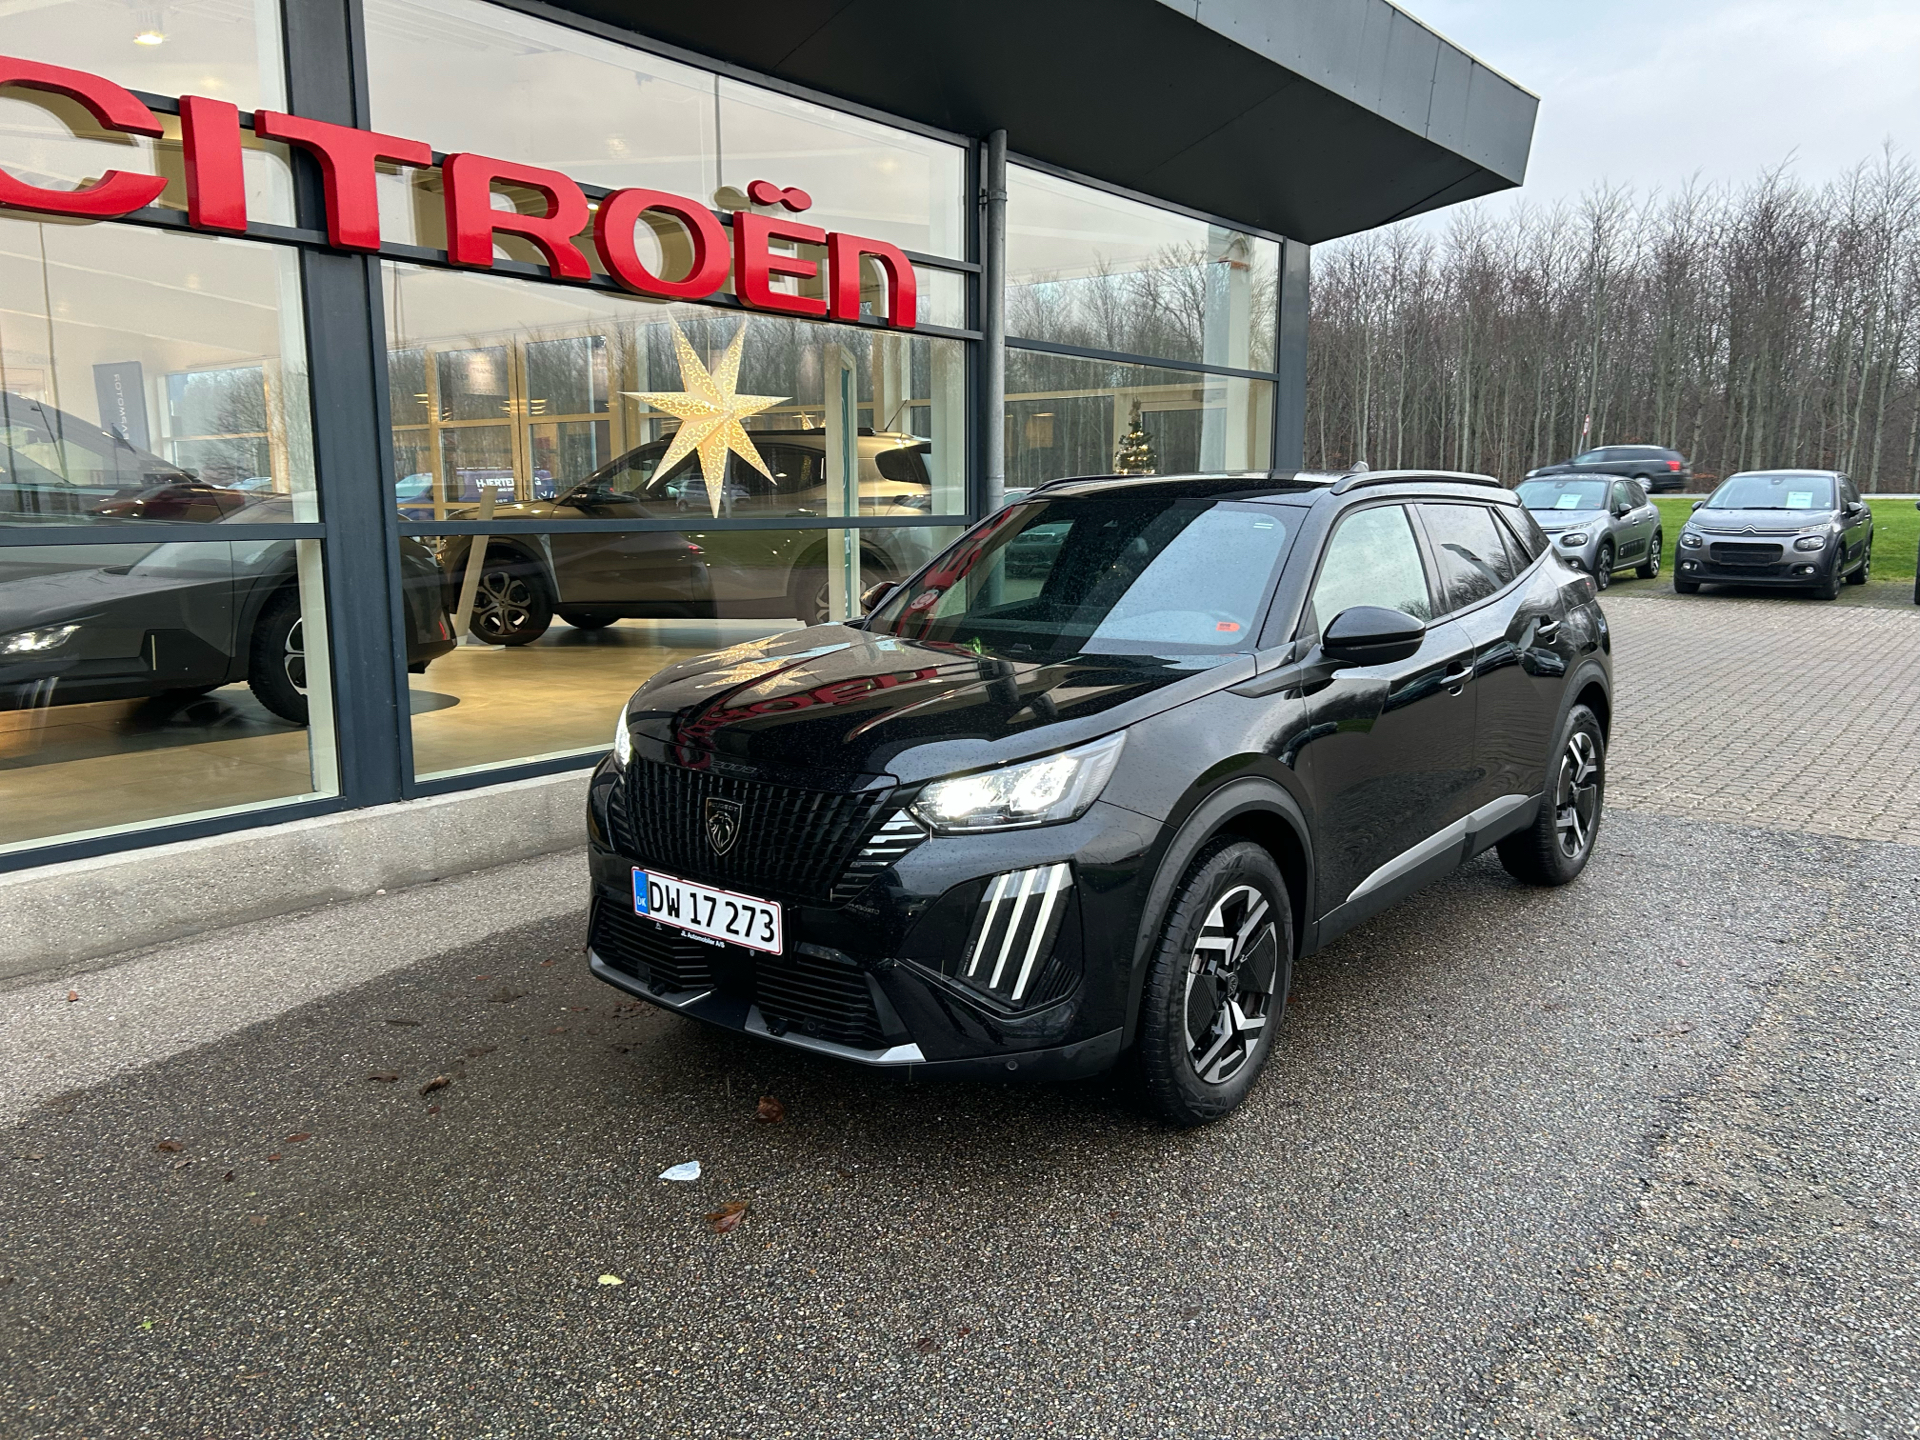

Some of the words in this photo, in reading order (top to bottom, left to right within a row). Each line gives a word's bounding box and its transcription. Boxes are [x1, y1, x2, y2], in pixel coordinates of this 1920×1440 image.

[0, 56, 917, 329] CITROËN
[711, 760, 757, 773] 2008
[708, 801, 738, 811] PEUGEOT
[637, 895, 647, 908] DK
[650, 881, 680, 919] DW
[690, 892, 717, 928] 17
[725, 901, 775, 943] 273
